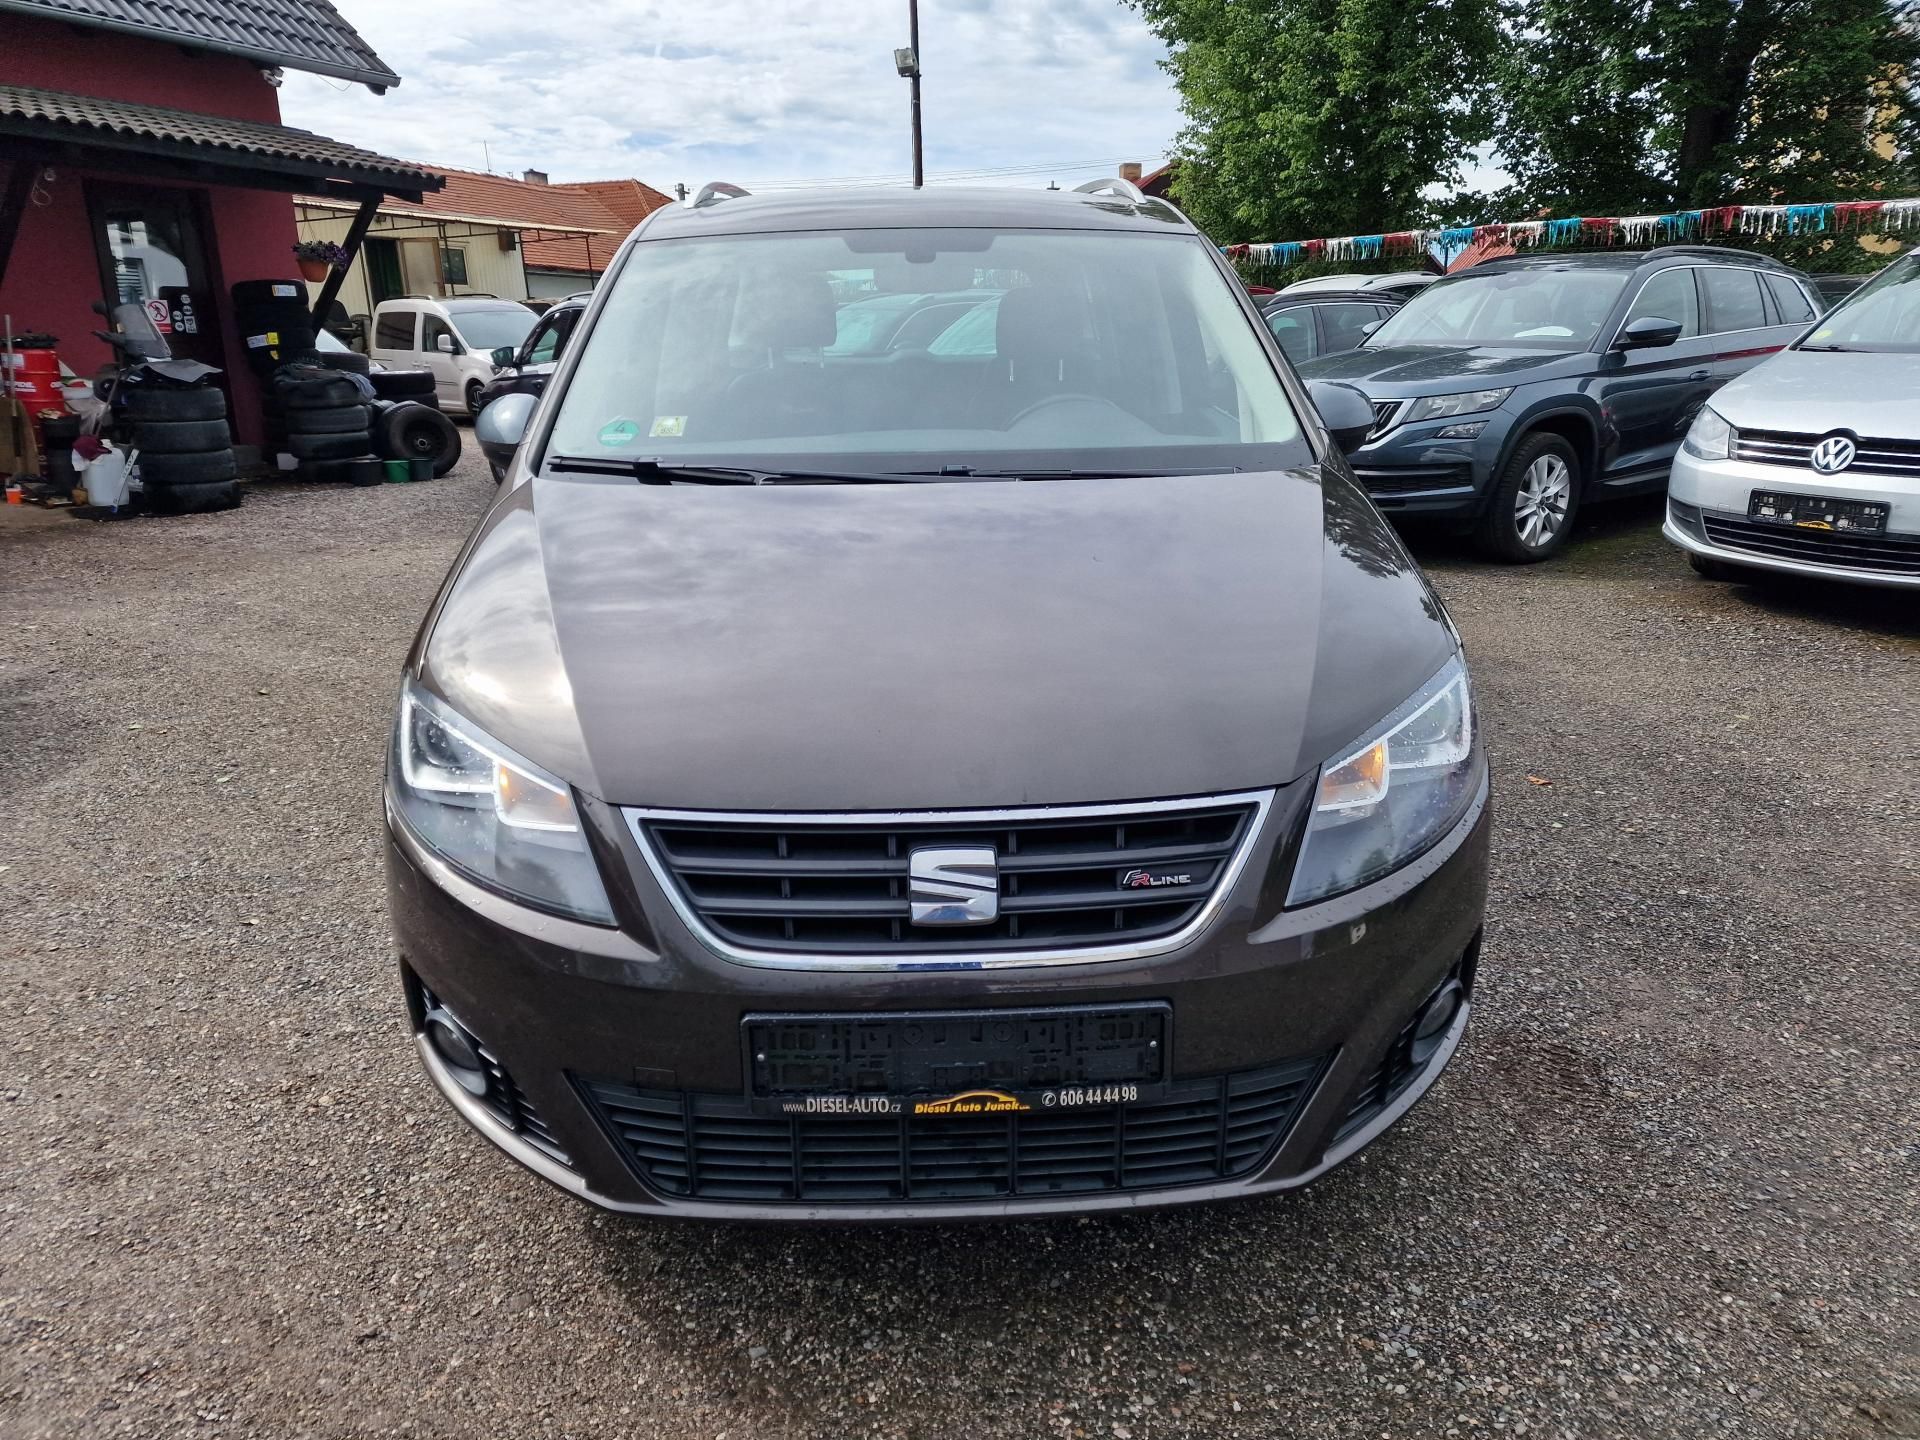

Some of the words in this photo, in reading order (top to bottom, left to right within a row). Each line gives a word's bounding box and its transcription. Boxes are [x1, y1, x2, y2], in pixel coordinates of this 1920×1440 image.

[782, 1097, 902, 1113] www.DIESEL-AUTO.cz
[914, 1102, 951, 1114] Diesel
[953, 1102, 982, 1113] Auto
